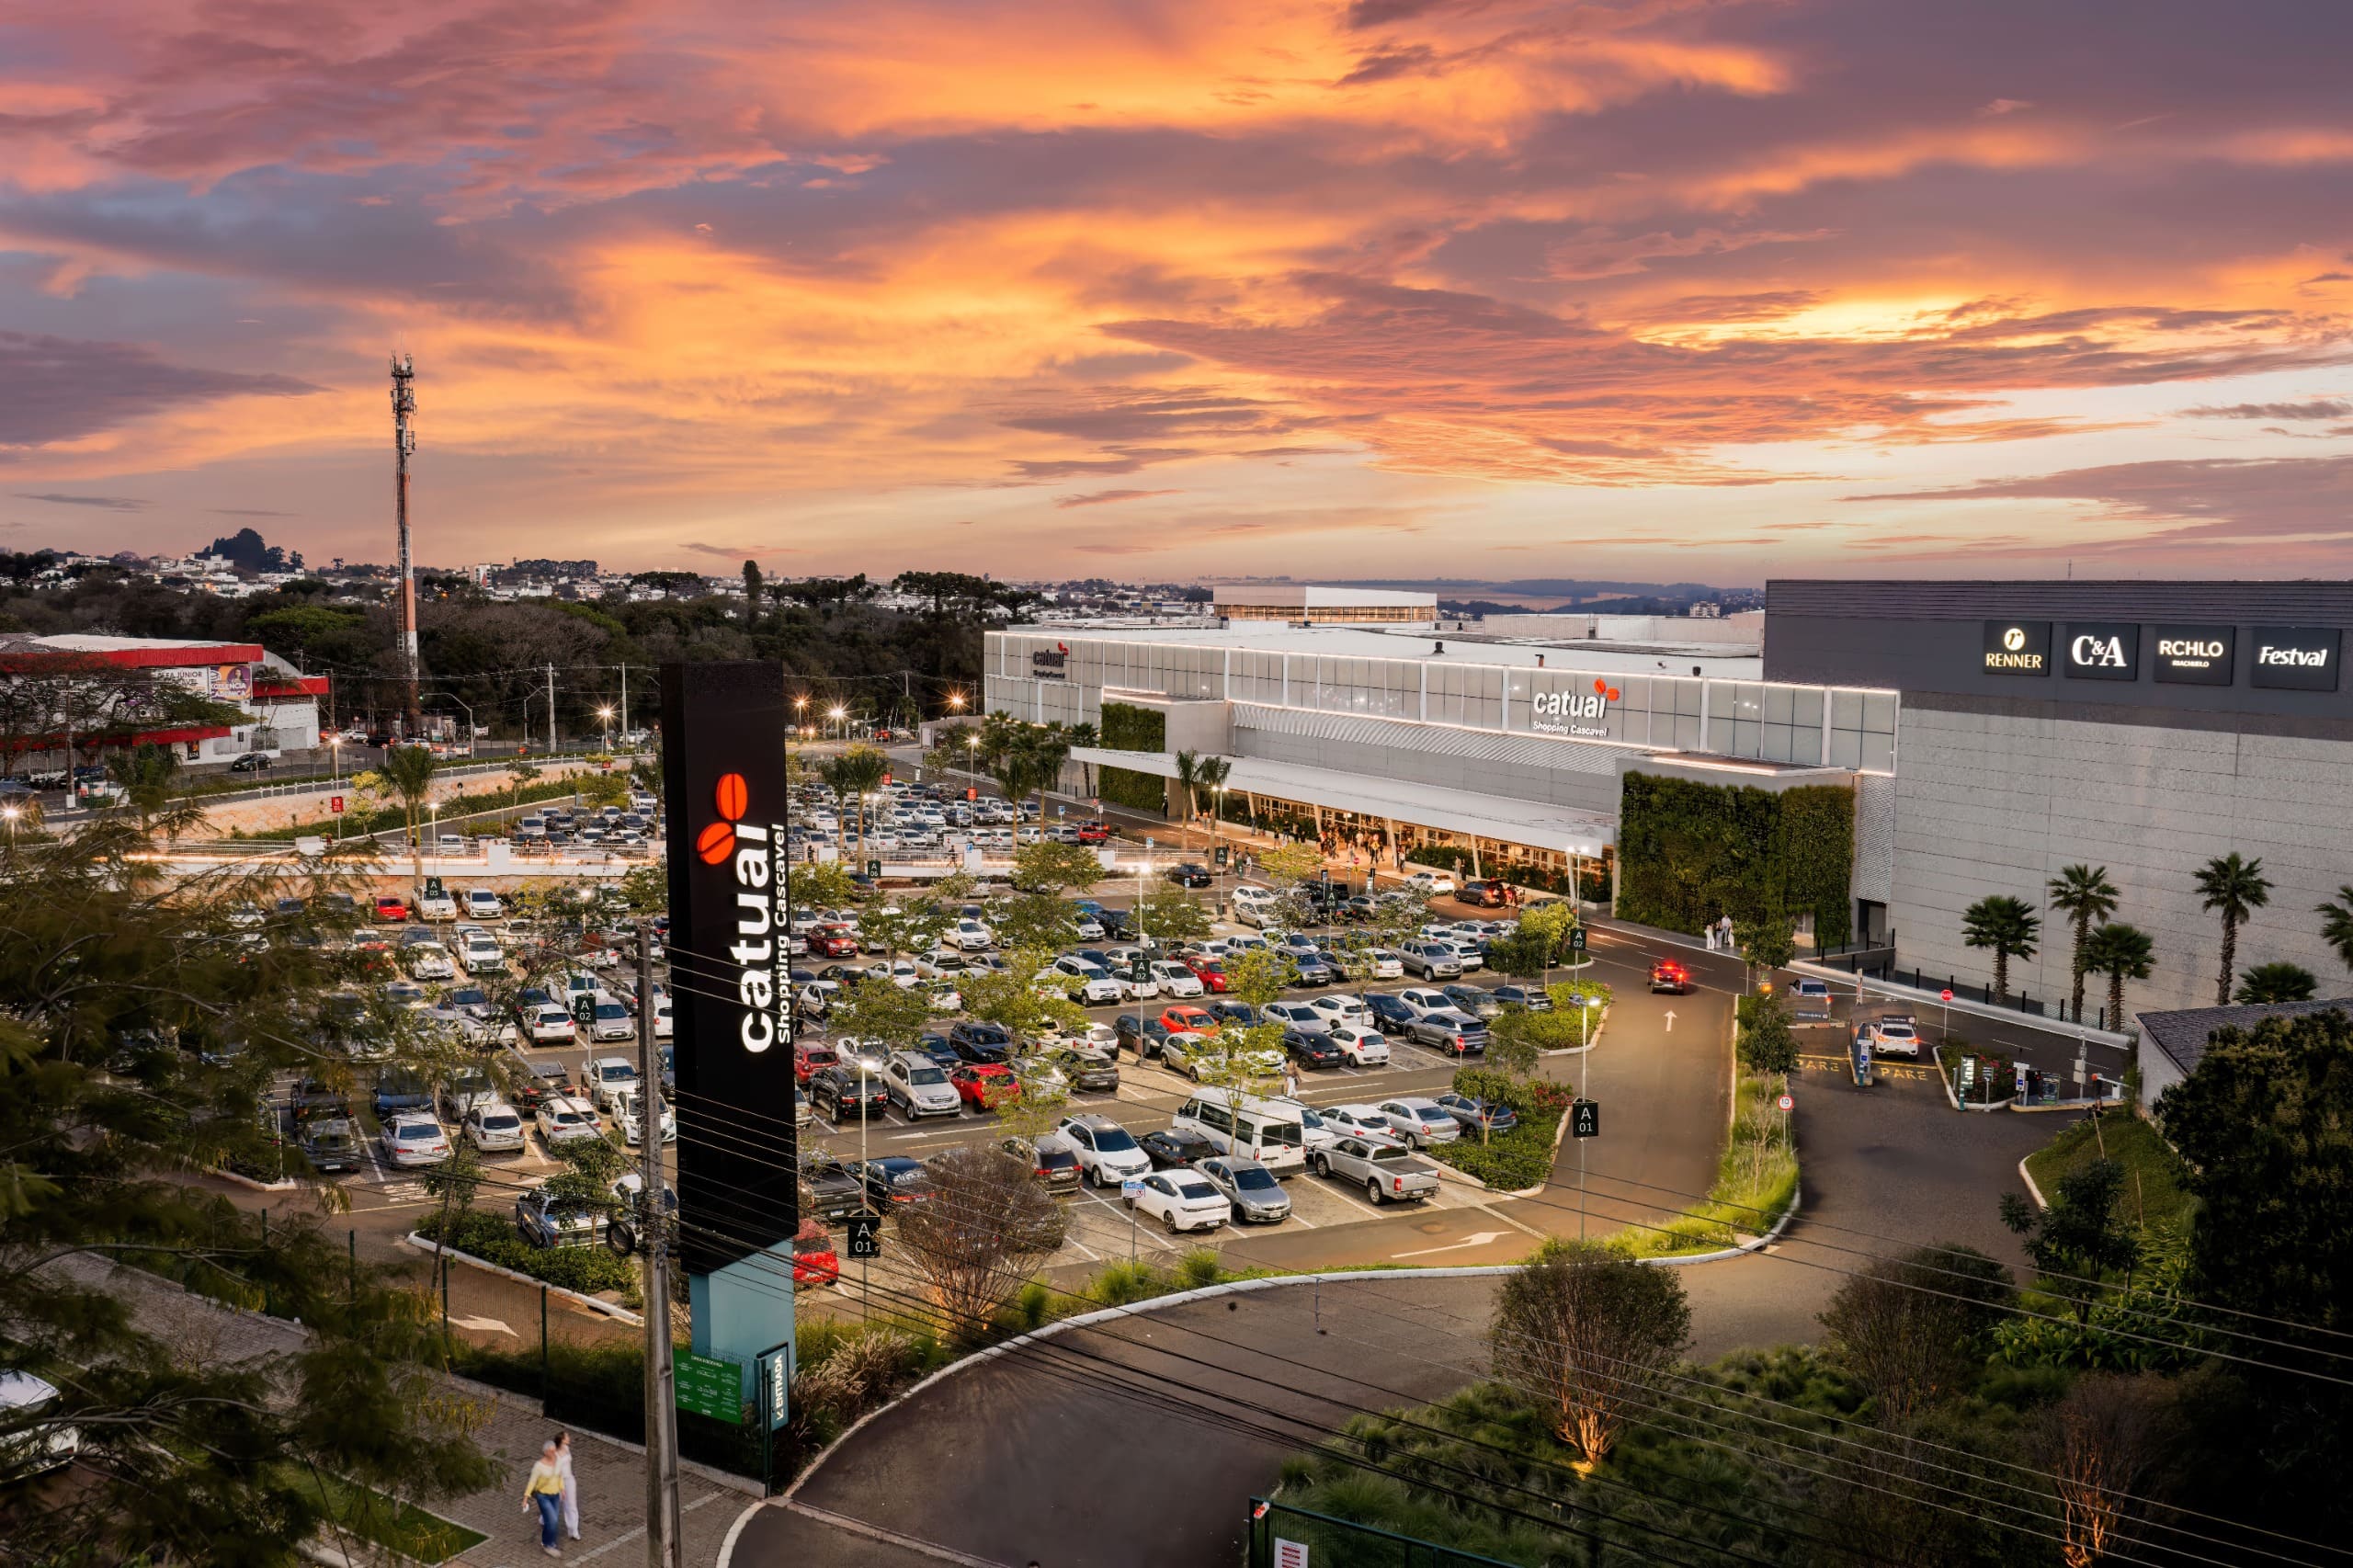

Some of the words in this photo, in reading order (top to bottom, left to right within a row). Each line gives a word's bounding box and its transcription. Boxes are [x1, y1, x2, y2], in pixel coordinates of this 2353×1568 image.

[2071, 634, 2128, 667] C&A
[2158, 640, 2224, 657] RCHLO
[2258, 645, 2328, 666] Festval
[1985, 653, 2042, 669] RENNER
[1533, 721, 1570, 735] Shopping
[1570, 724, 1608, 736] Cascavel
[771, 824, 787, 927] Cascavel
[430, 881, 438, 889] A
[1575, 931, 1583, 939] A
[1137, 962, 1145, 971] A
[776, 935, 790, 1044] Shopping
[580, 1000, 590, 1010] A
[579, 1012, 592, 1021] 02
[1880, 1066, 1929, 1081] PARE
[1580, 1107, 1592, 1120] A
[1579, 1121, 1593, 1132] 01
[857, 1222, 871, 1237] A
[855, 1241, 872, 1253] 01
[774, 1354, 784, 1409] ENTRADA
